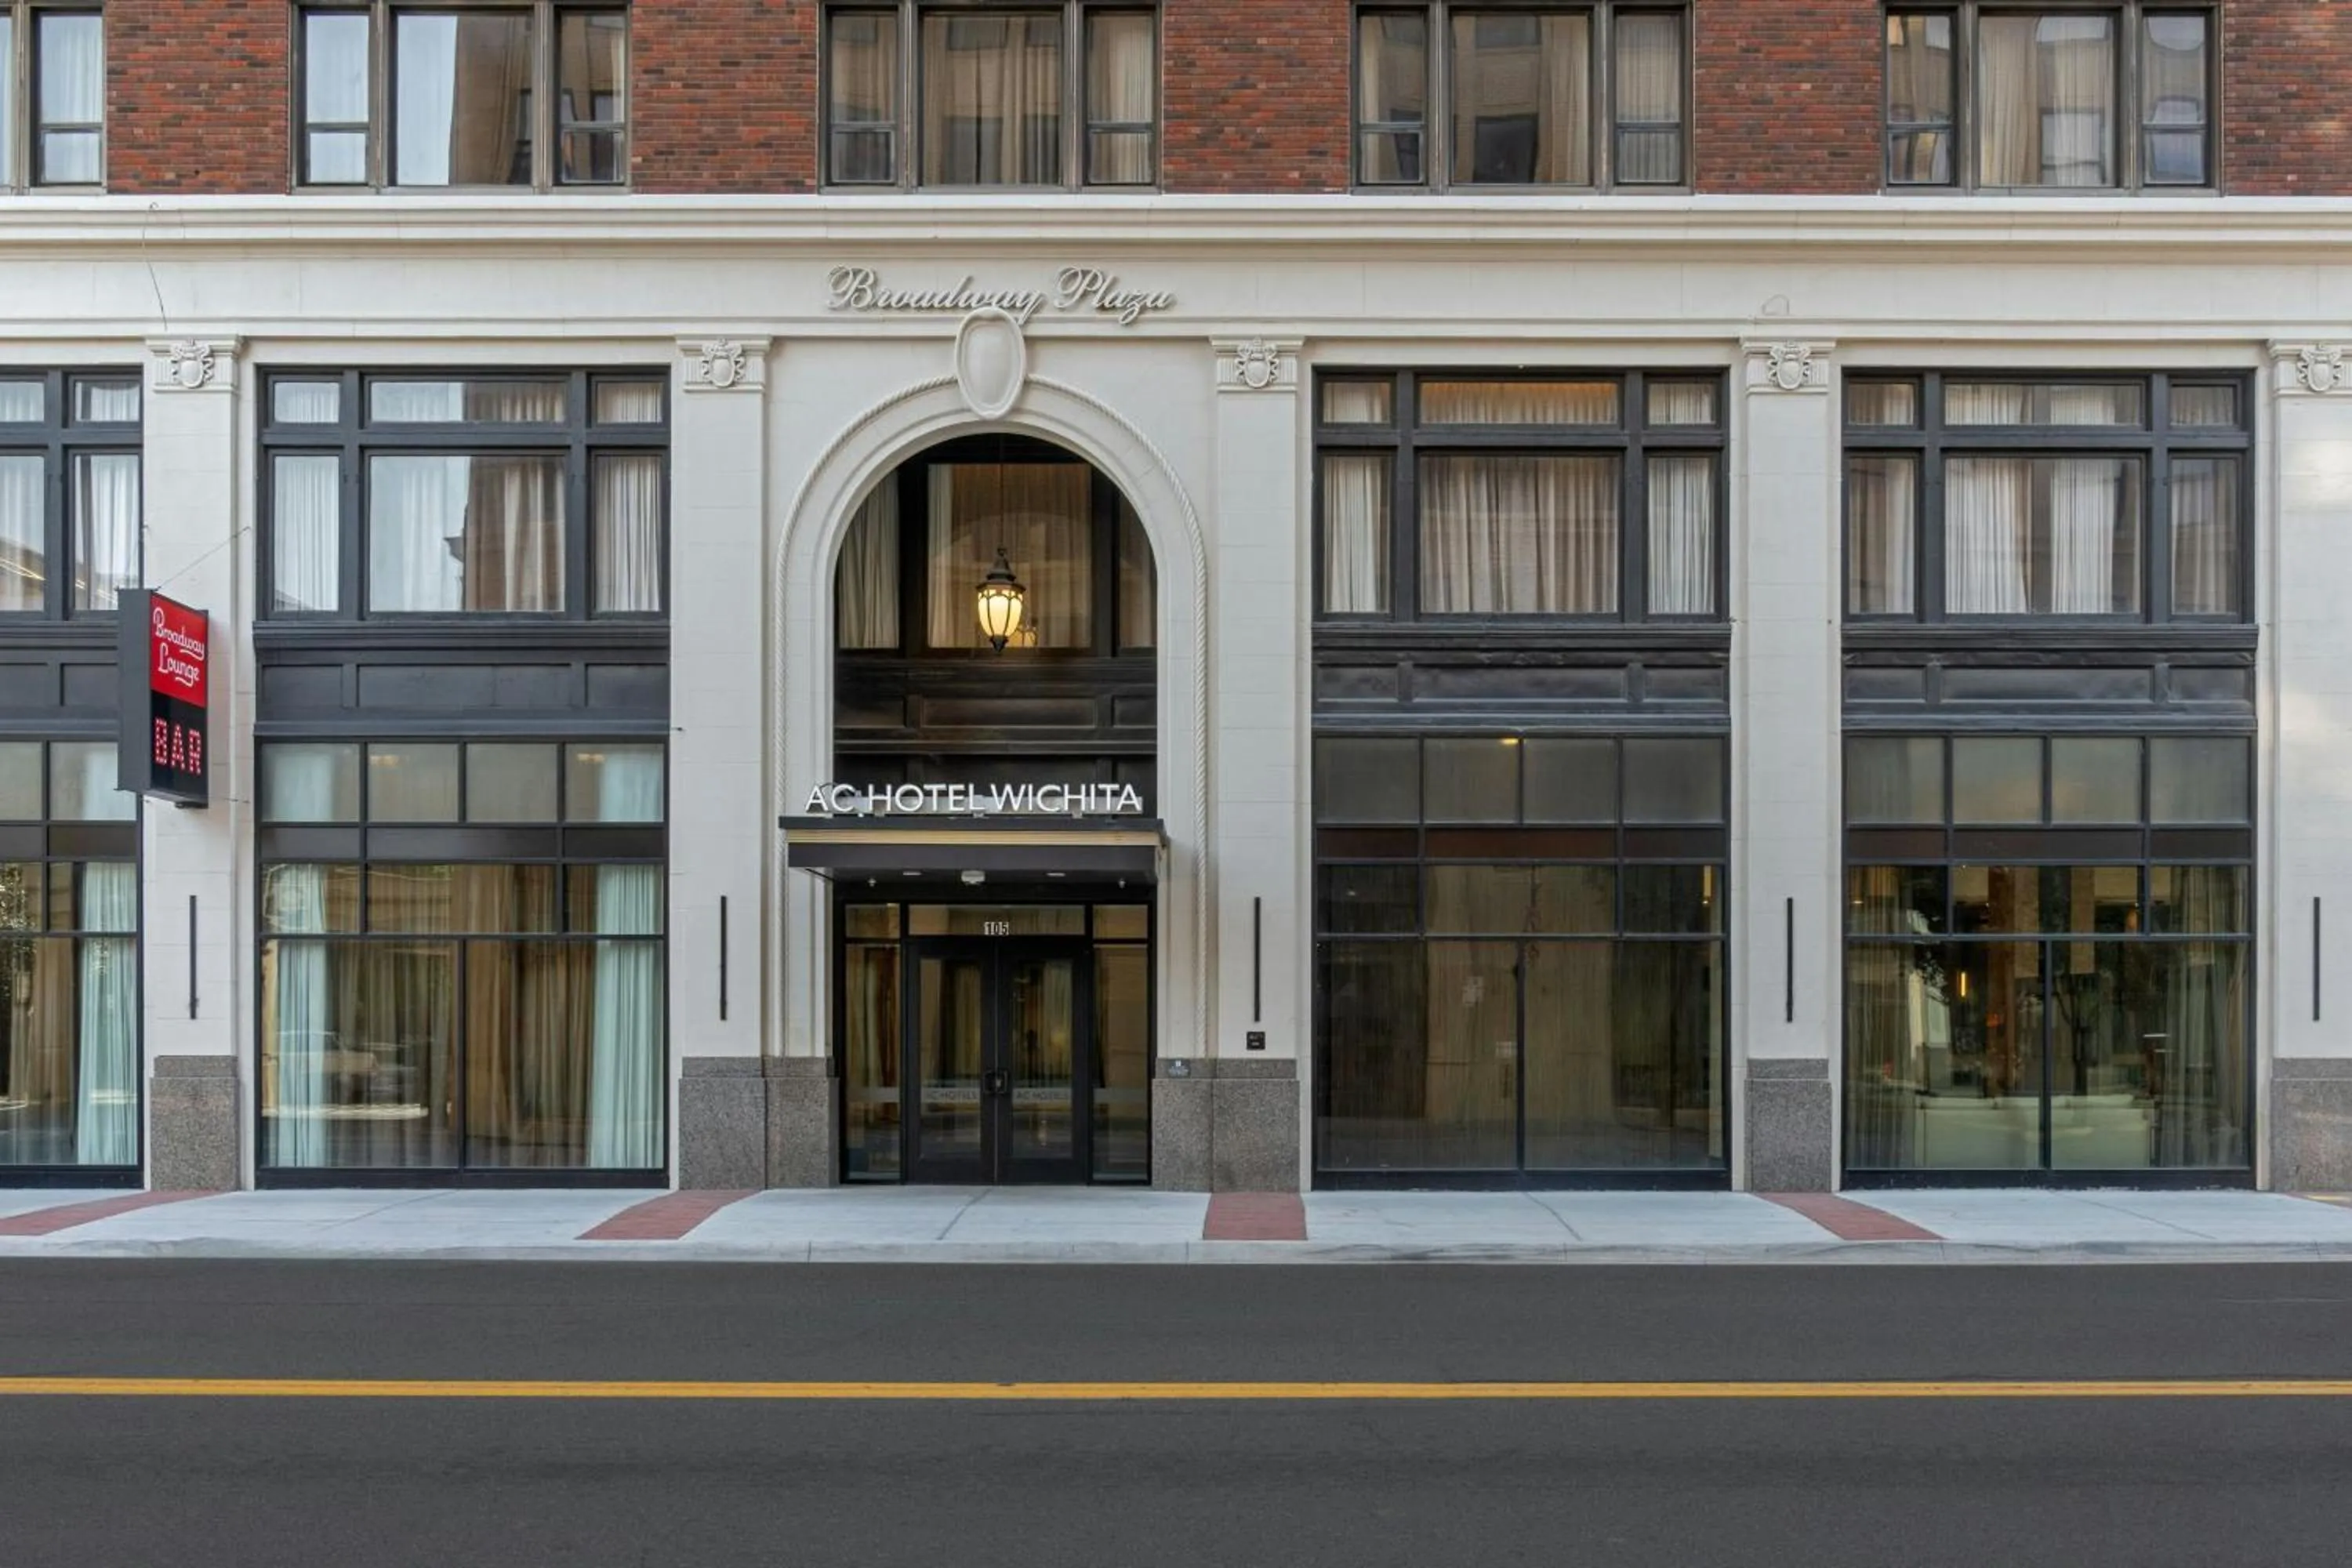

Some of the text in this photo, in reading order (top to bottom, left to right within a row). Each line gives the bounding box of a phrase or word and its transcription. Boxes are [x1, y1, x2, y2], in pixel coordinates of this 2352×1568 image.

[827, 265, 1173, 325] Broadway Plaza
[153, 607, 204, 661] Broadway
[158, 642, 199, 687] Lounge
[155, 718, 201, 775] BAR
[805, 783, 1142, 812] AC HOTEL WICHITA
[986, 921, 1009, 936] 105
